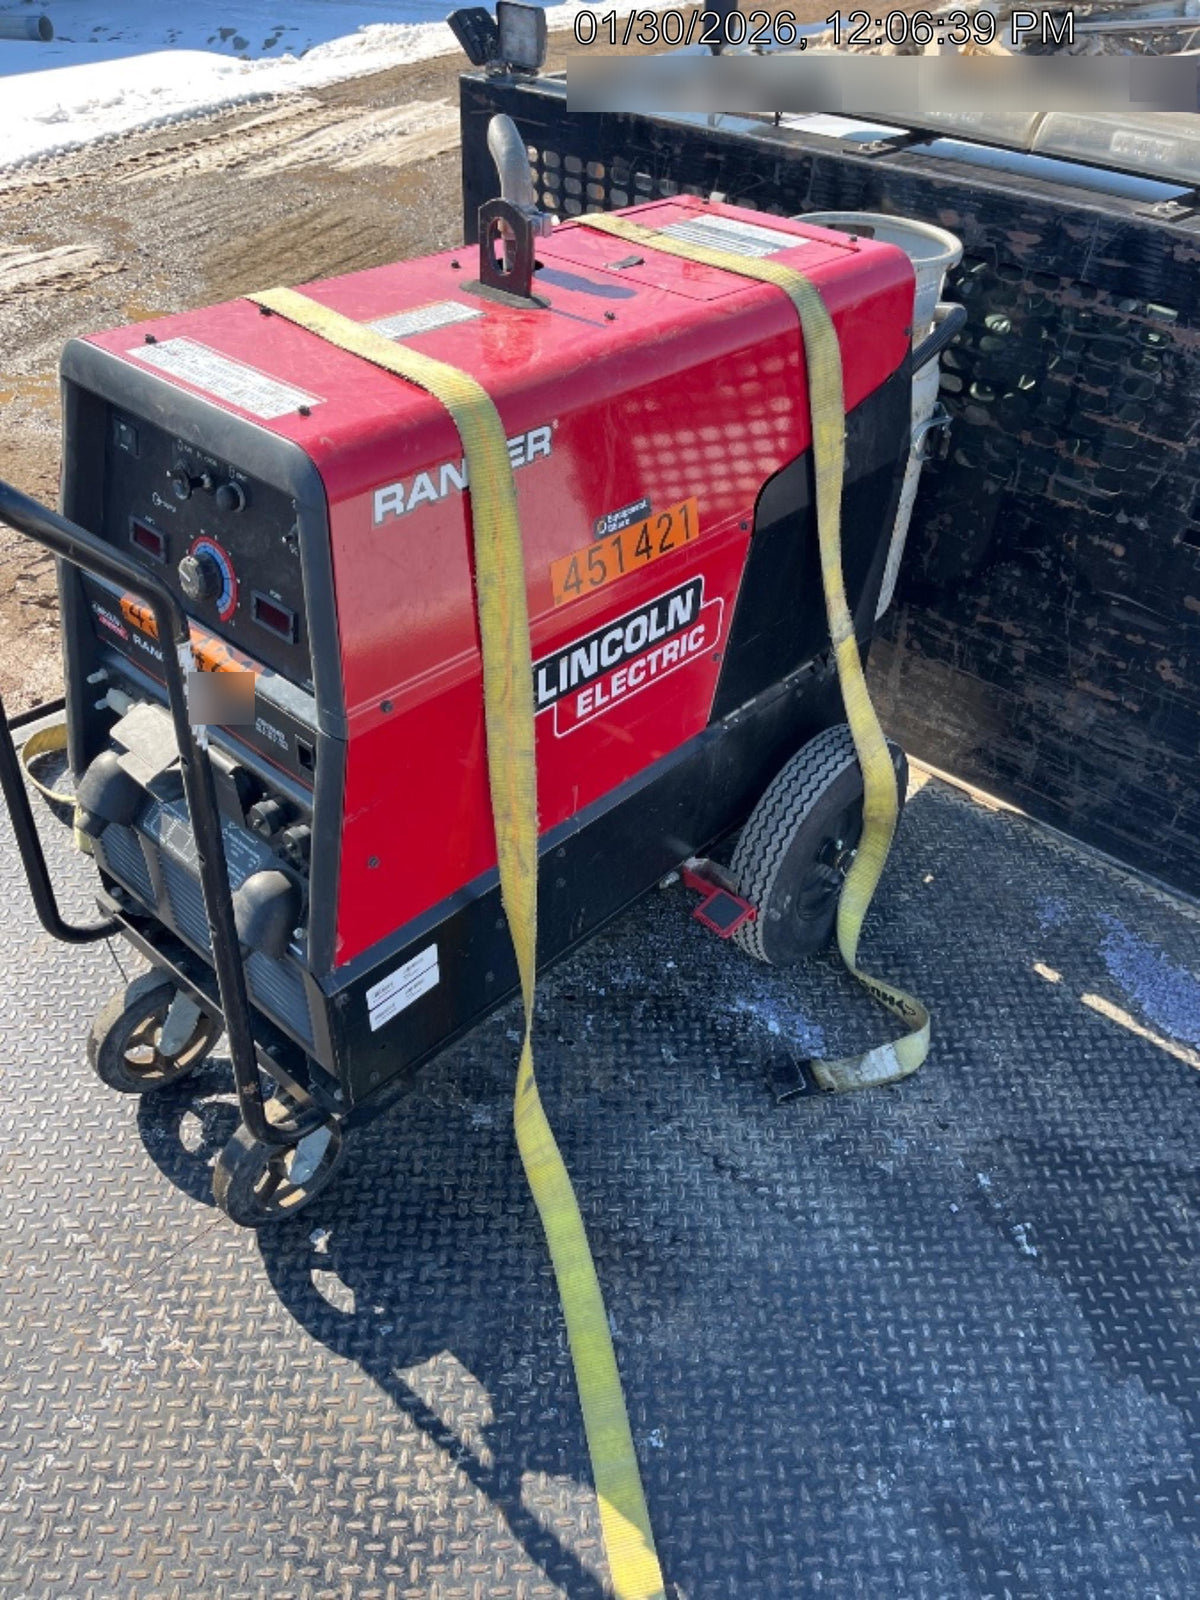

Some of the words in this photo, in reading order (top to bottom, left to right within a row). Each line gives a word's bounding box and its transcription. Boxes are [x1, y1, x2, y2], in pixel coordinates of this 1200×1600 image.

[372, 423, 553, 527] RANER
[562, 503, 692, 594] 451421
[537, 587, 695, 704] LINCOLN
[575, 624, 706, 718] ELECTRIC
